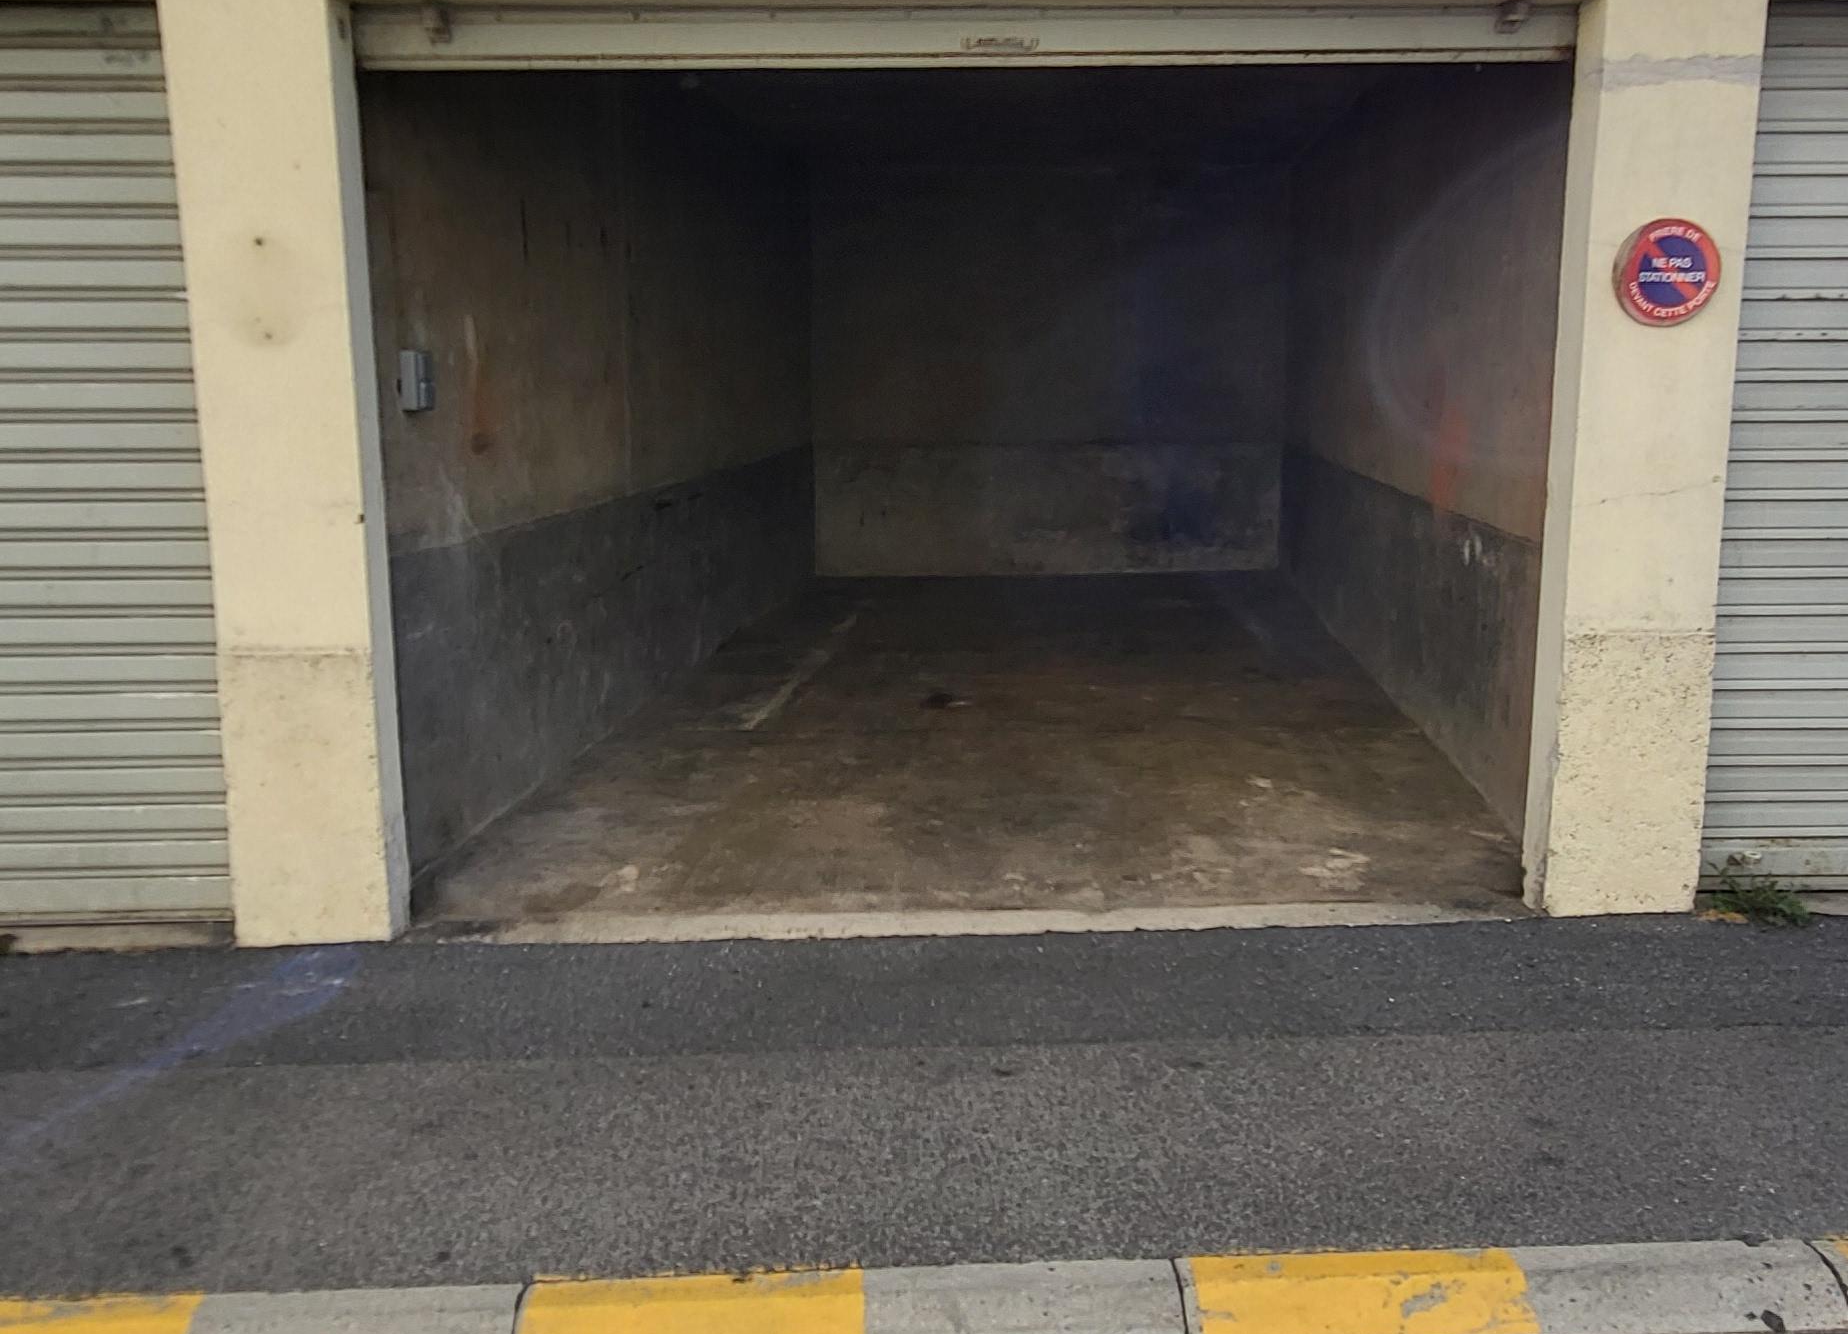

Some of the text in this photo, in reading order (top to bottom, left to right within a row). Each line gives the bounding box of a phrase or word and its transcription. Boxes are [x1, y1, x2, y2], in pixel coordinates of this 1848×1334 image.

[1685, 228, 1702, 243] DE
[1651, 257, 1694, 268] NE PAS
[1638, 271, 1706, 283] STATIONNER
[1629, 280, 1718, 318] DEVANT CETTE PORTE
